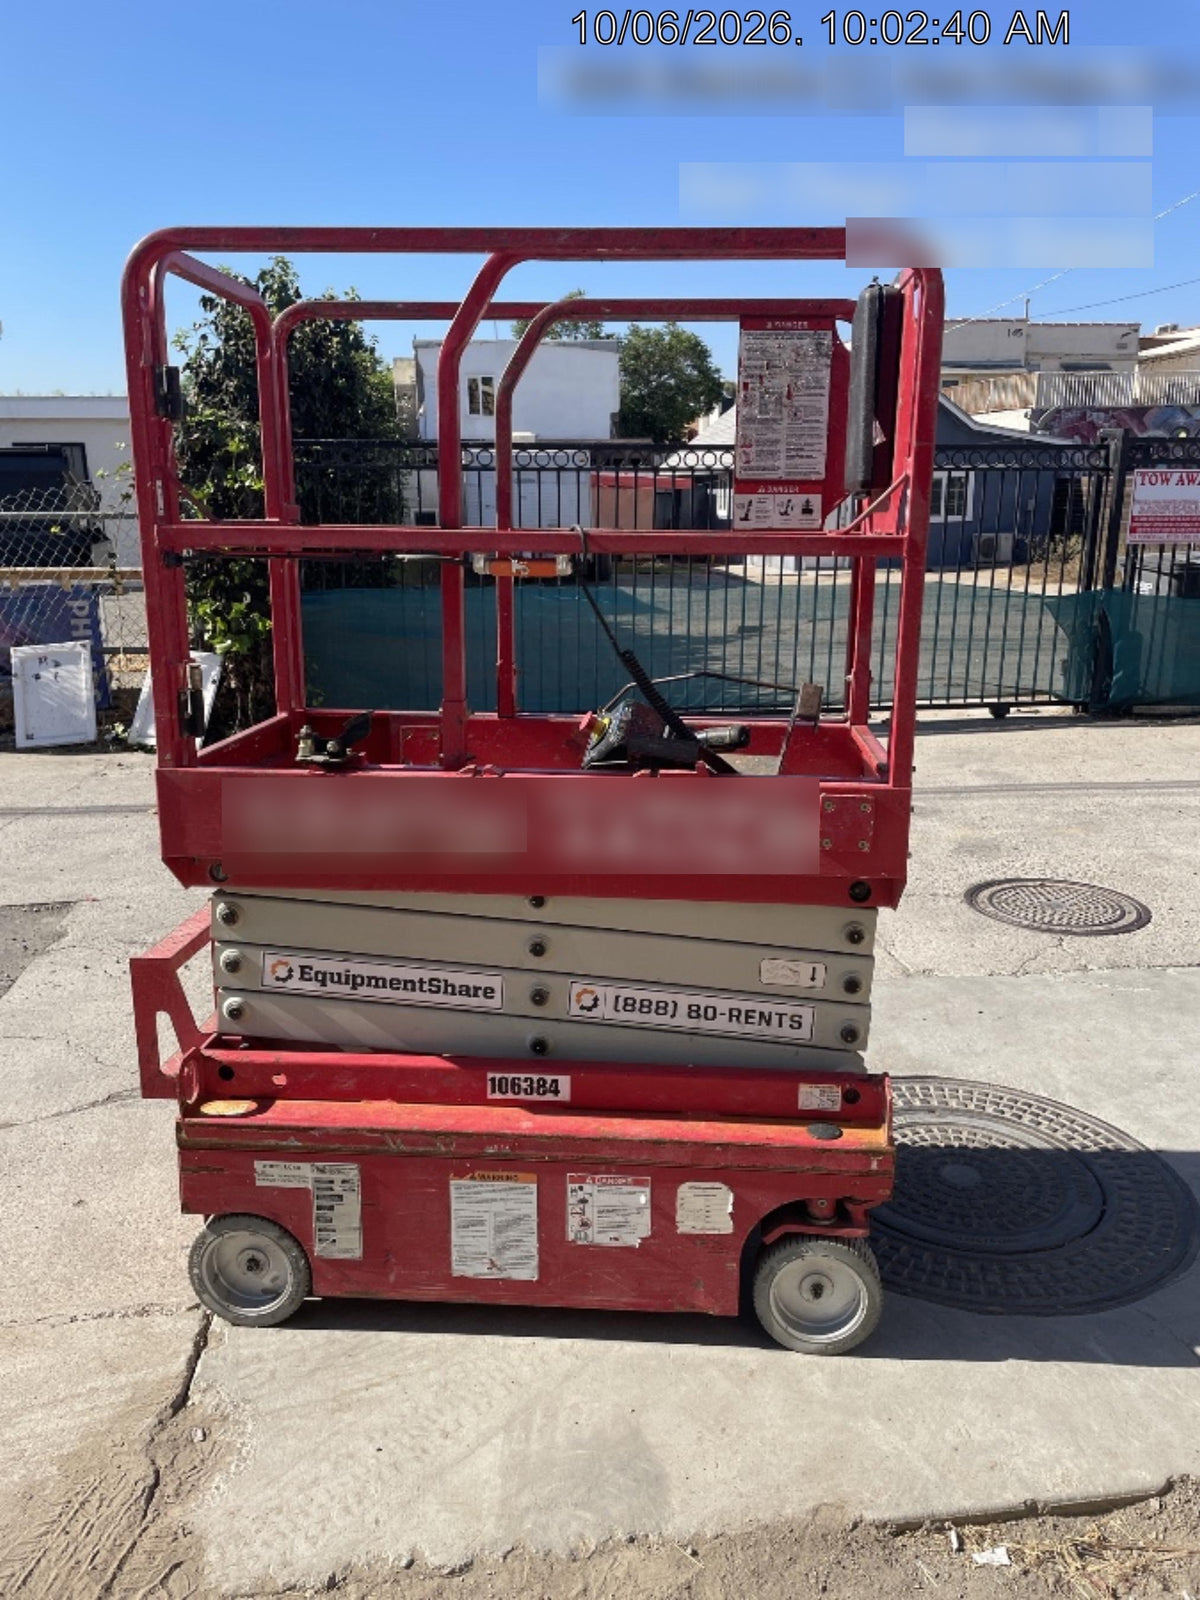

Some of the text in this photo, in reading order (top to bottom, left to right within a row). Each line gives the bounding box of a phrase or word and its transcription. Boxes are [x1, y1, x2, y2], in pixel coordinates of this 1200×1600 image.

[1139, 472, 1200, 486] TOW AW
[297, 964, 497, 1001] EquipmentShare
[613, 994, 804, 1031] (888) 80-RENTS
[488, 1075, 561, 1098] 106384
